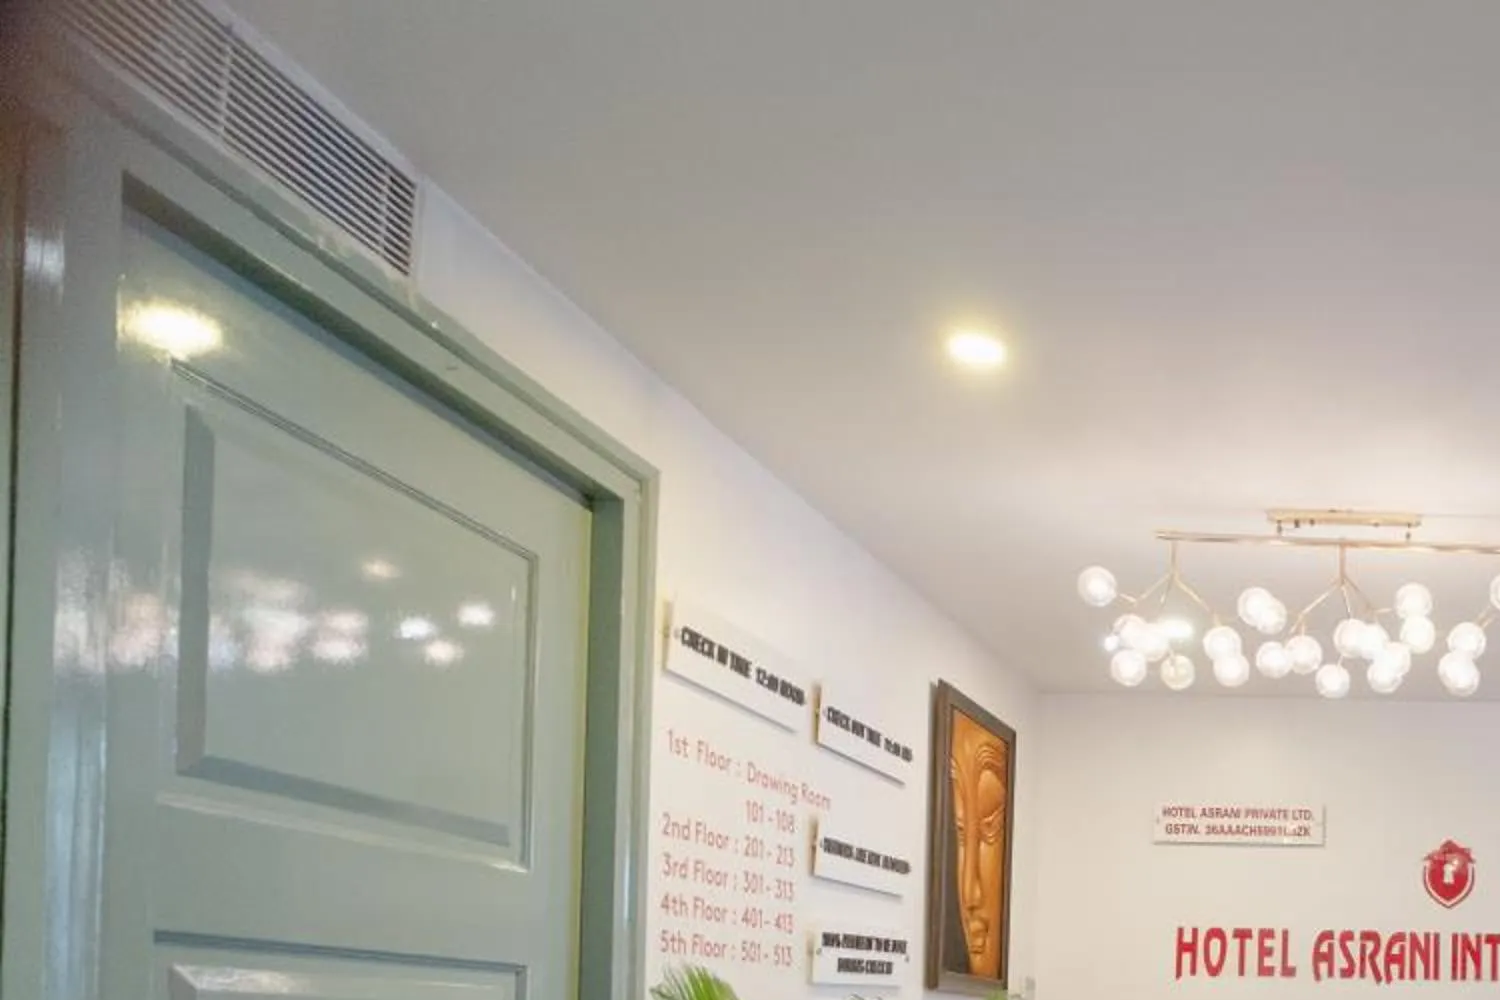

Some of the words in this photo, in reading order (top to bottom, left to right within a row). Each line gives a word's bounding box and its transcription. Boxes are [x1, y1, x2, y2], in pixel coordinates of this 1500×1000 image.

[668, 729, 689, 758] 1st
[697, 739, 732, 775] Floor
[747, 761, 799, 805] Drawing
[801, 783, 831, 810] Room
[746, 800, 764, 824] 101
[1162, 806, 1196, 818] HOTEL
[1200, 807, 1241, 819] ASRANI
[1245, 808, 1288, 820] PRIVATE
[662, 811, 691, 841] 2nd
[695, 821, 730, 851] Floor
[744, 835, 764, 860] 201
[662, 852, 689, 879] 3rd
[694, 860, 728, 889] Floor
[743, 870, 763, 894] 301
[660, 892, 688, 917] 4th
[693, 896, 728, 923] Floor
[741, 906, 763, 929] 401
[660, 929, 687, 955] 5th
[692, 933, 727, 958] Floor
[741, 940, 761, 962] 501
[1176, 927, 1296, 980] HOTEL
[1312, 930, 1440, 983] ASRANI
